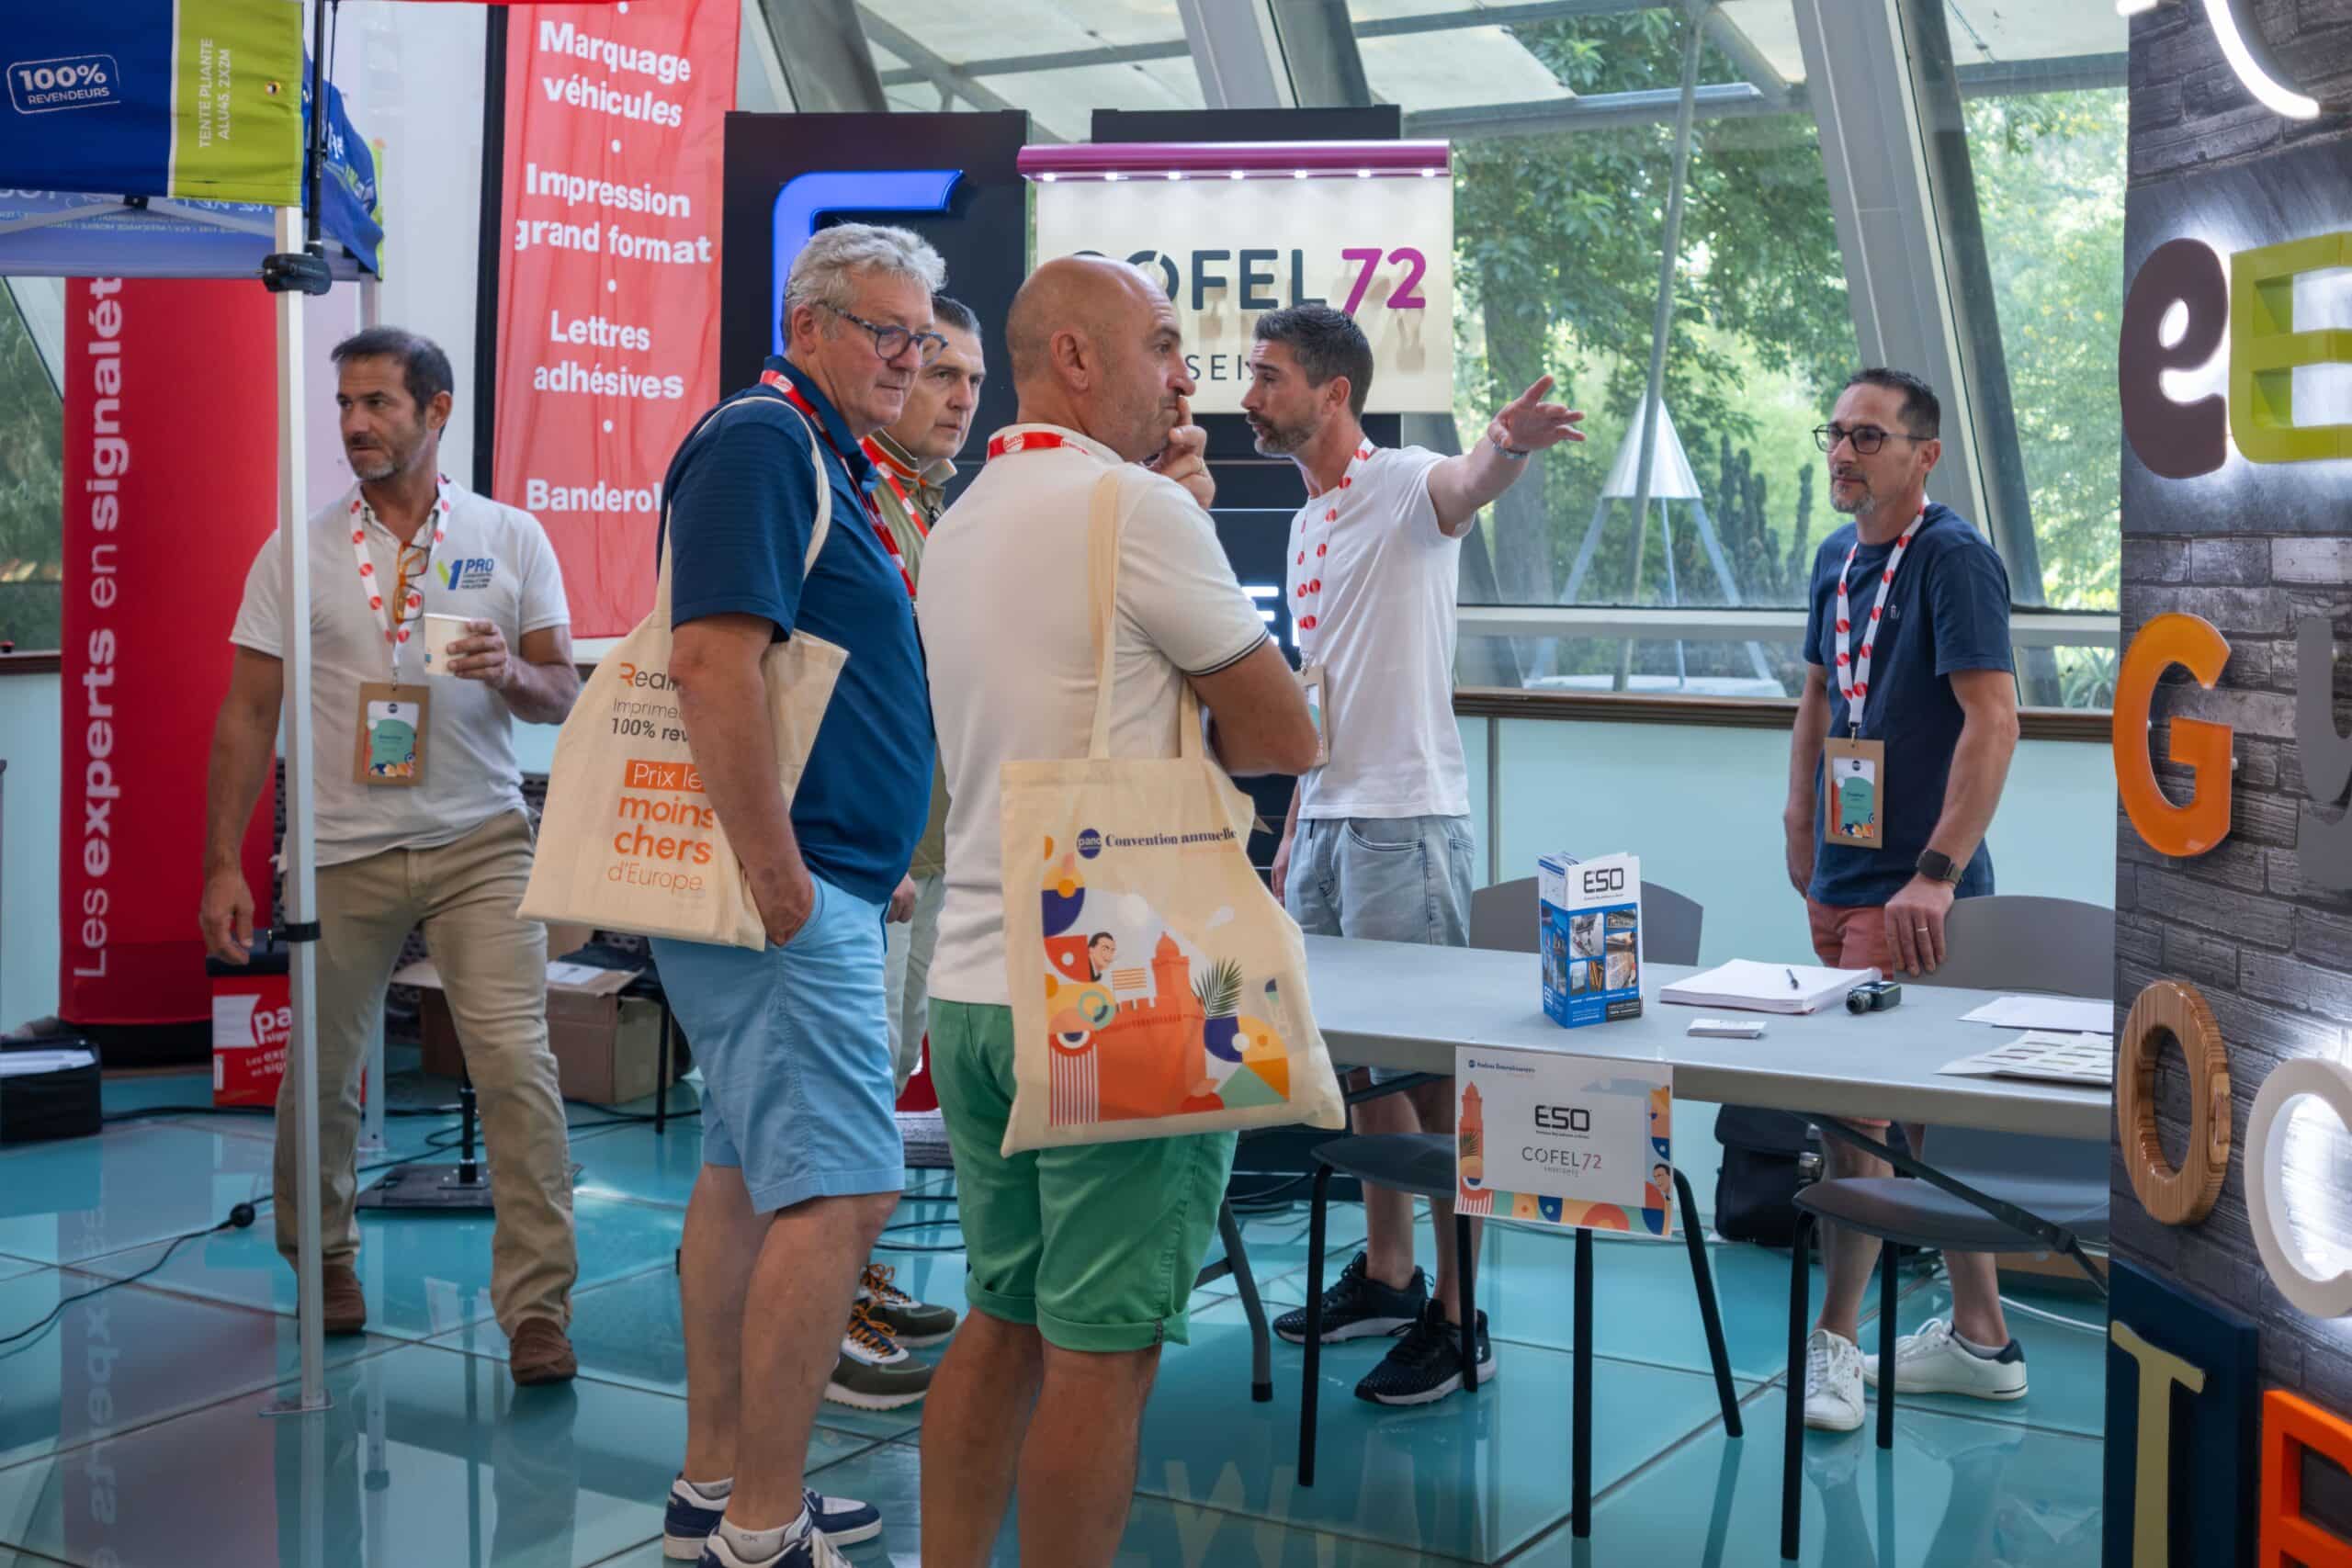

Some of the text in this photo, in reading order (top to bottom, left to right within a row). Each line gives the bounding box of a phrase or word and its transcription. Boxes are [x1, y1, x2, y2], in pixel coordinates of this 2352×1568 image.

[539, 20, 691, 85] Marquage
[18, 63, 107, 91] 100%
[28, 86, 110, 105] REVENDEURS
[198, 37, 213, 148] TENTE PLIANTE
[543, 73, 682, 128] véhicules
[526, 163, 690, 218] Impression
[514, 221, 713, 264] grand format
[1073, 249, 1327, 310] OFEL
[551, 310, 650, 351] Lettres
[534, 360, 684, 400] adhésives
[91, 544, 118, 608] en
[465, 558, 494, 573] PRO
[612, 717, 656, 739] 100%
[614, 698, 684, 720] Imprime
[83, 628, 120, 876] experts
[633, 762, 676, 787] Prix
[617, 795, 714, 830] moins
[614, 823, 712, 864] chers
[1105, 832, 1178, 847] Convention
[1182, 827, 1237, 843] annuelle
[607, 860, 704, 897] d'Europe
[1583, 867, 1624, 894] ESO
[74, 888, 108, 977] Les
[1535, 1105, 1590, 1132] ESO
